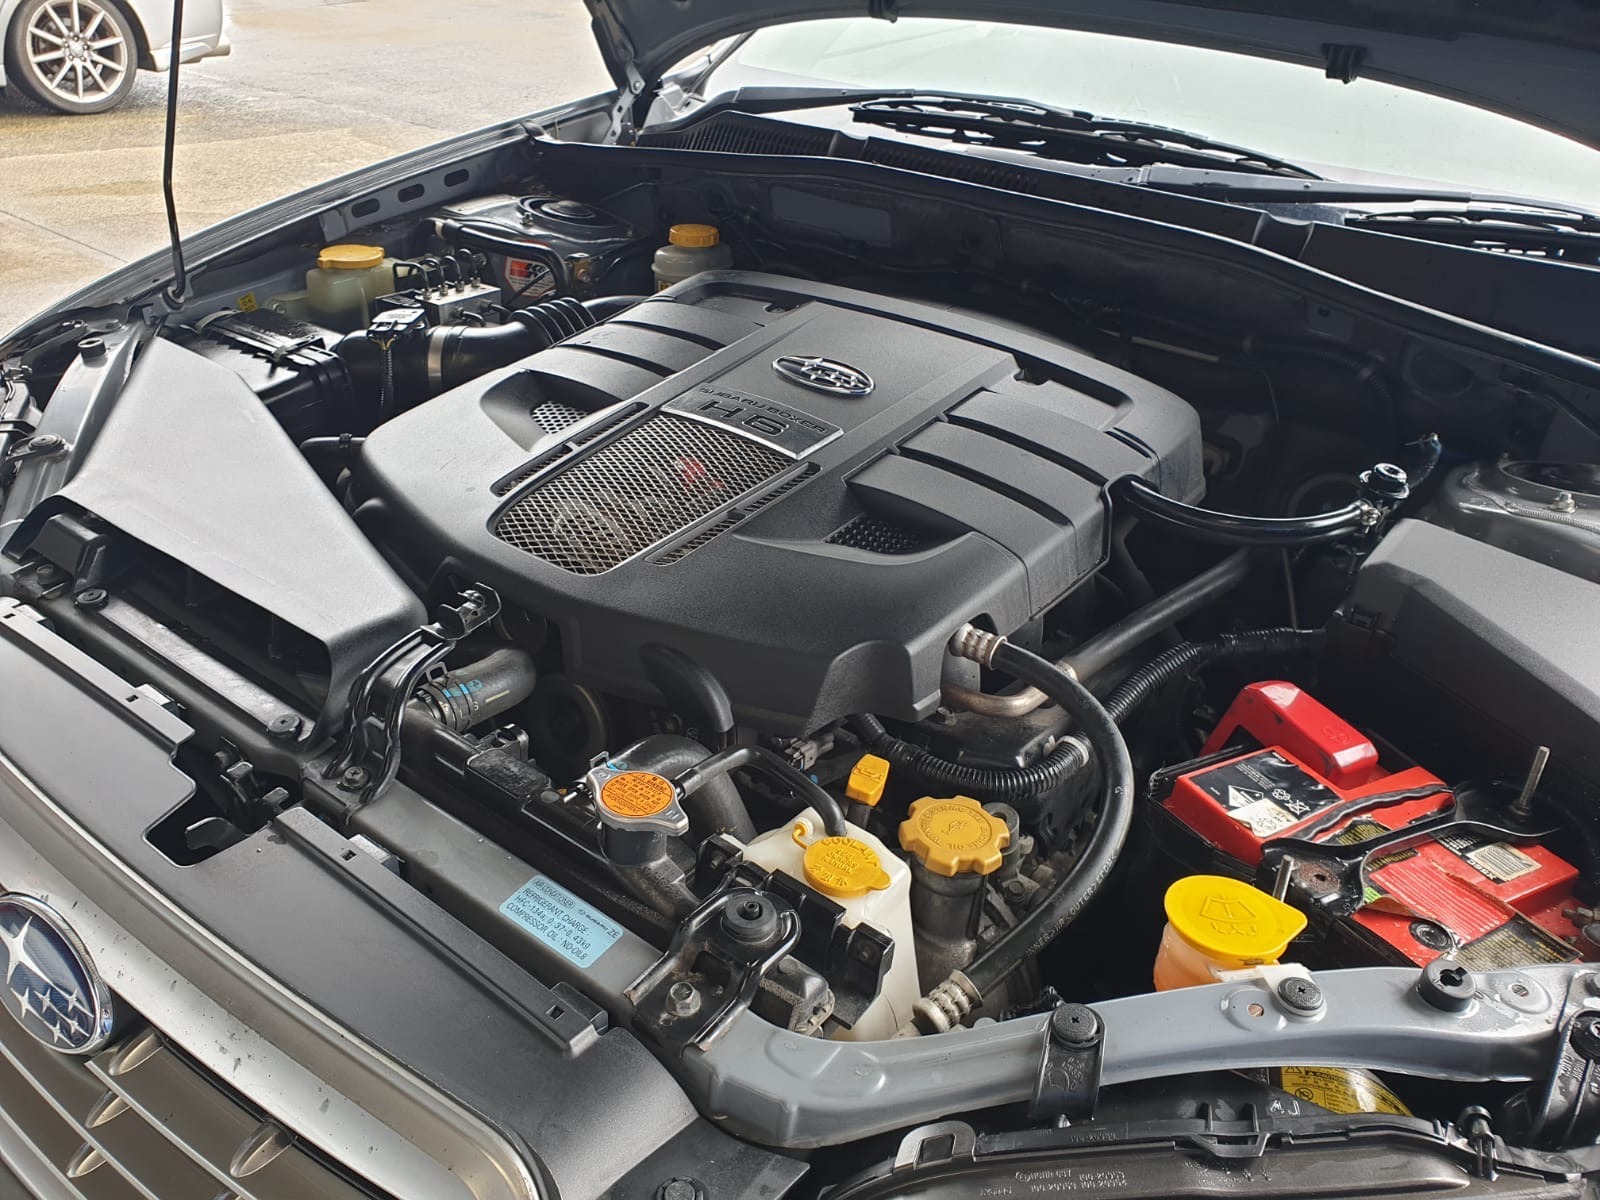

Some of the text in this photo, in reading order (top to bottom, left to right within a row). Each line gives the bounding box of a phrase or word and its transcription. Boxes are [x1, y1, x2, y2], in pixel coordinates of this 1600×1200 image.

[699, 400, 789, 437] H6
[700, 387, 827, 434] SUBARU BOXER
[506, 902, 549, 934] COMPRESSOR
[547, 930, 558, 942] OIL
[522, 887, 564, 919] REFRIGERANT
[562, 914, 589, 935] CHARGE
